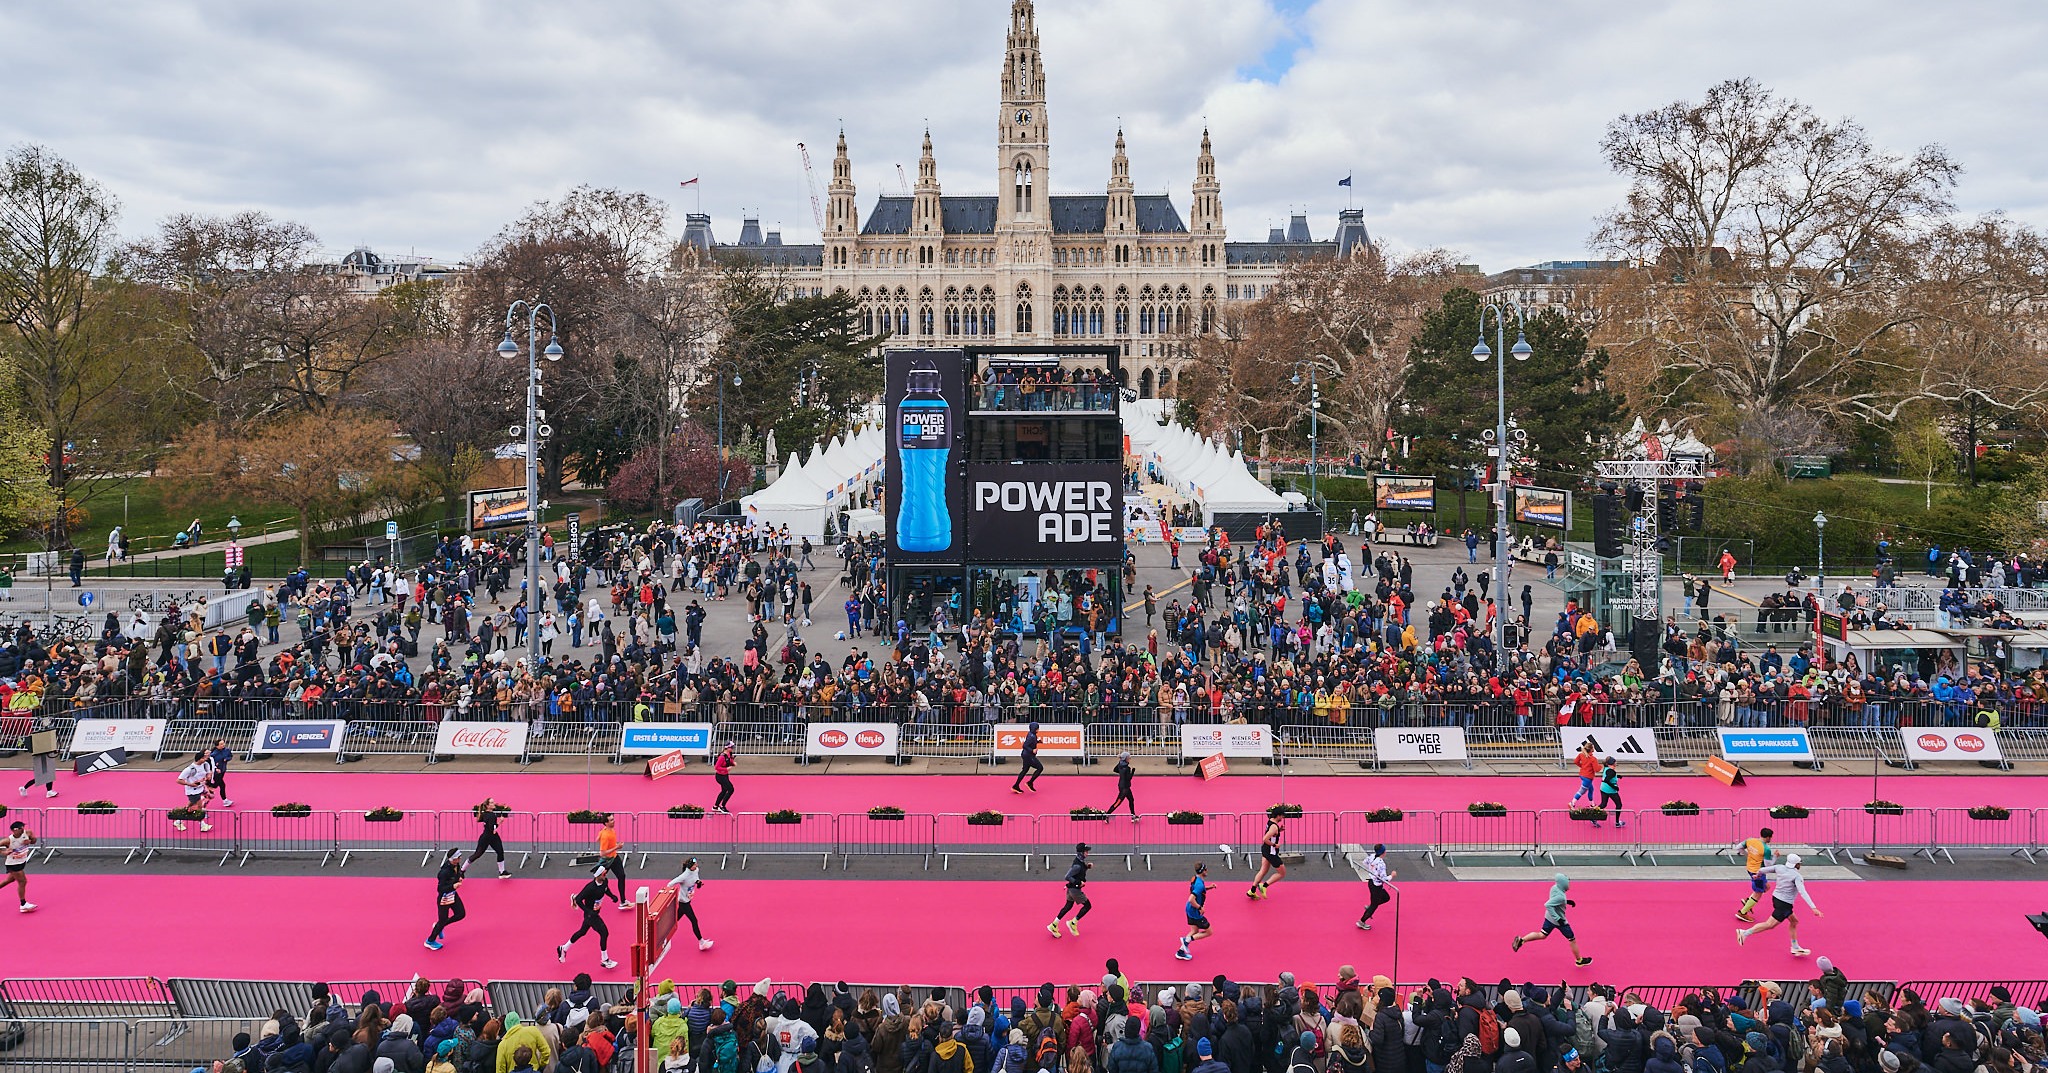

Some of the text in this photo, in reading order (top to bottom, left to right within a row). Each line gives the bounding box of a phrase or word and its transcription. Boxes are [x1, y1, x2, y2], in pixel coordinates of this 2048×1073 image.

[903, 413, 945, 425] POWER
[921, 424, 946, 435] ADE
[976, 481, 1112, 511] POWER
[1038, 512, 1112, 543] ADE
[570, 521, 578, 552] COFFEE
[633, 734, 693, 742] ERSTE SPARKASSE
[821, 733, 846, 745] Hervis
[858, 733, 883, 745] Hervis
[1042, 736, 1078, 744] ENERGIE
[1398, 733, 1440, 744] POWER
[1919, 737, 1946, 748] Hervis
[1956, 737, 1983, 749] Hervis
[1418, 744, 1442, 754] ADE
